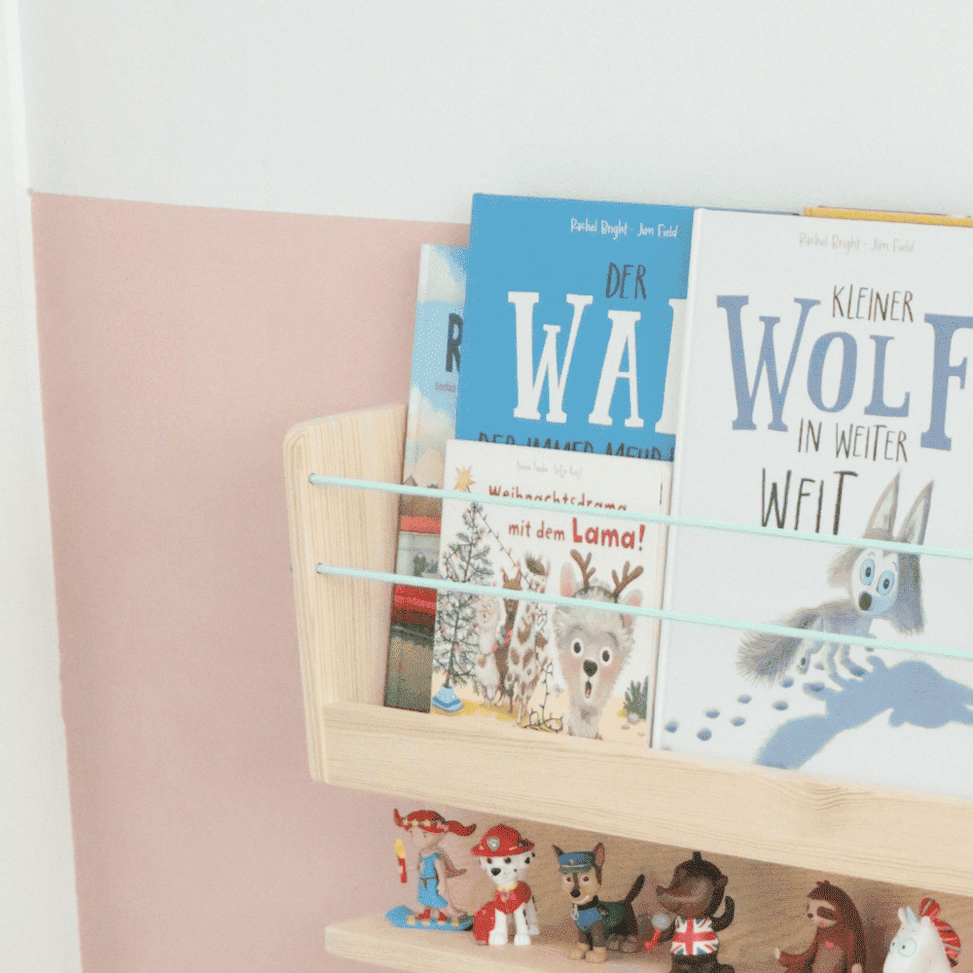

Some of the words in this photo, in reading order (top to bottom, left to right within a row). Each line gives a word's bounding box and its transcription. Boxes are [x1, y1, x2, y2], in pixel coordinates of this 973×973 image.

[570, 217, 598, 233] Rachel
[600, 219, 628, 241] Bright
[637, 221, 655, 238] Jim
[657, 223, 679, 239] Field
[798, 231, 828, 248] Rachel
[831, 233, 861, 256] Bright
[871, 236, 890, 252] Jim
[892, 238, 915, 254] Field
[605, 262, 647, 300] DER
[832, 283, 914, 323] KLEINER
[797, 418, 823, 453] IN
[834, 422, 909, 463] WEITER
[508, 520, 531, 537] mit
[536, 520, 565, 541] dem
[572, 517, 646, 551] Lama!
